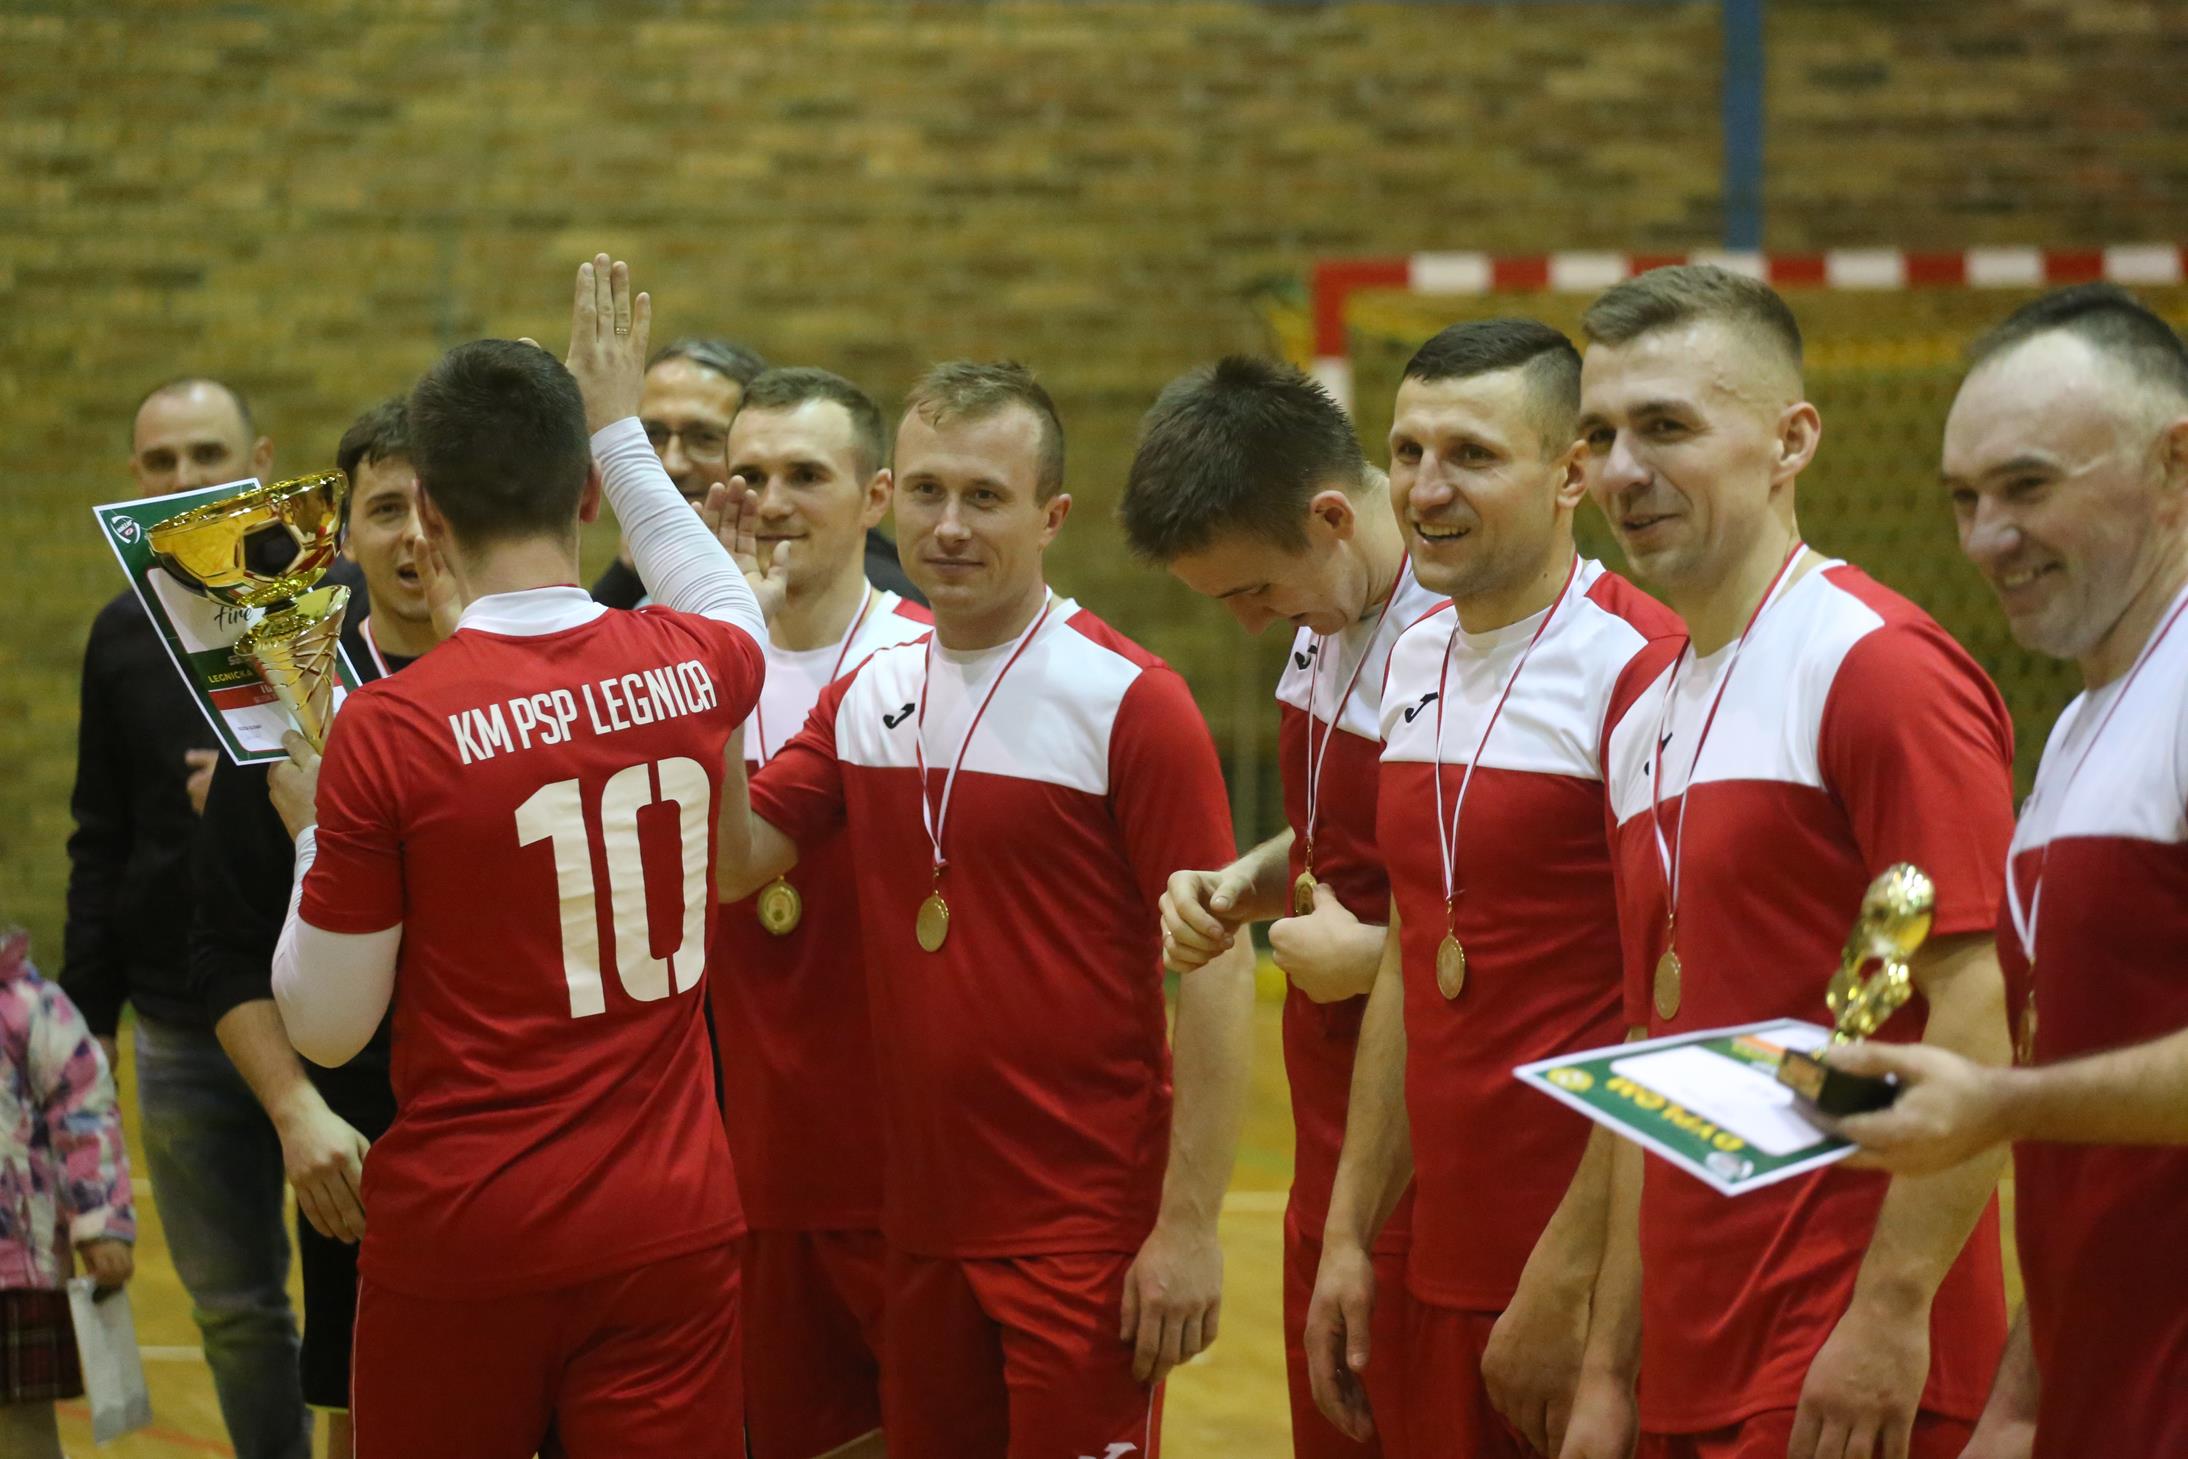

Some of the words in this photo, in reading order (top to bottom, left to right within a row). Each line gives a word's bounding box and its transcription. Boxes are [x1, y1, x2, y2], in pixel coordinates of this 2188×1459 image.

[449, 703, 515, 765] KM
[508, 689, 578, 749] PSP
[582, 659, 718, 735] LEGNICA
[513, 755, 711, 1019] 10
